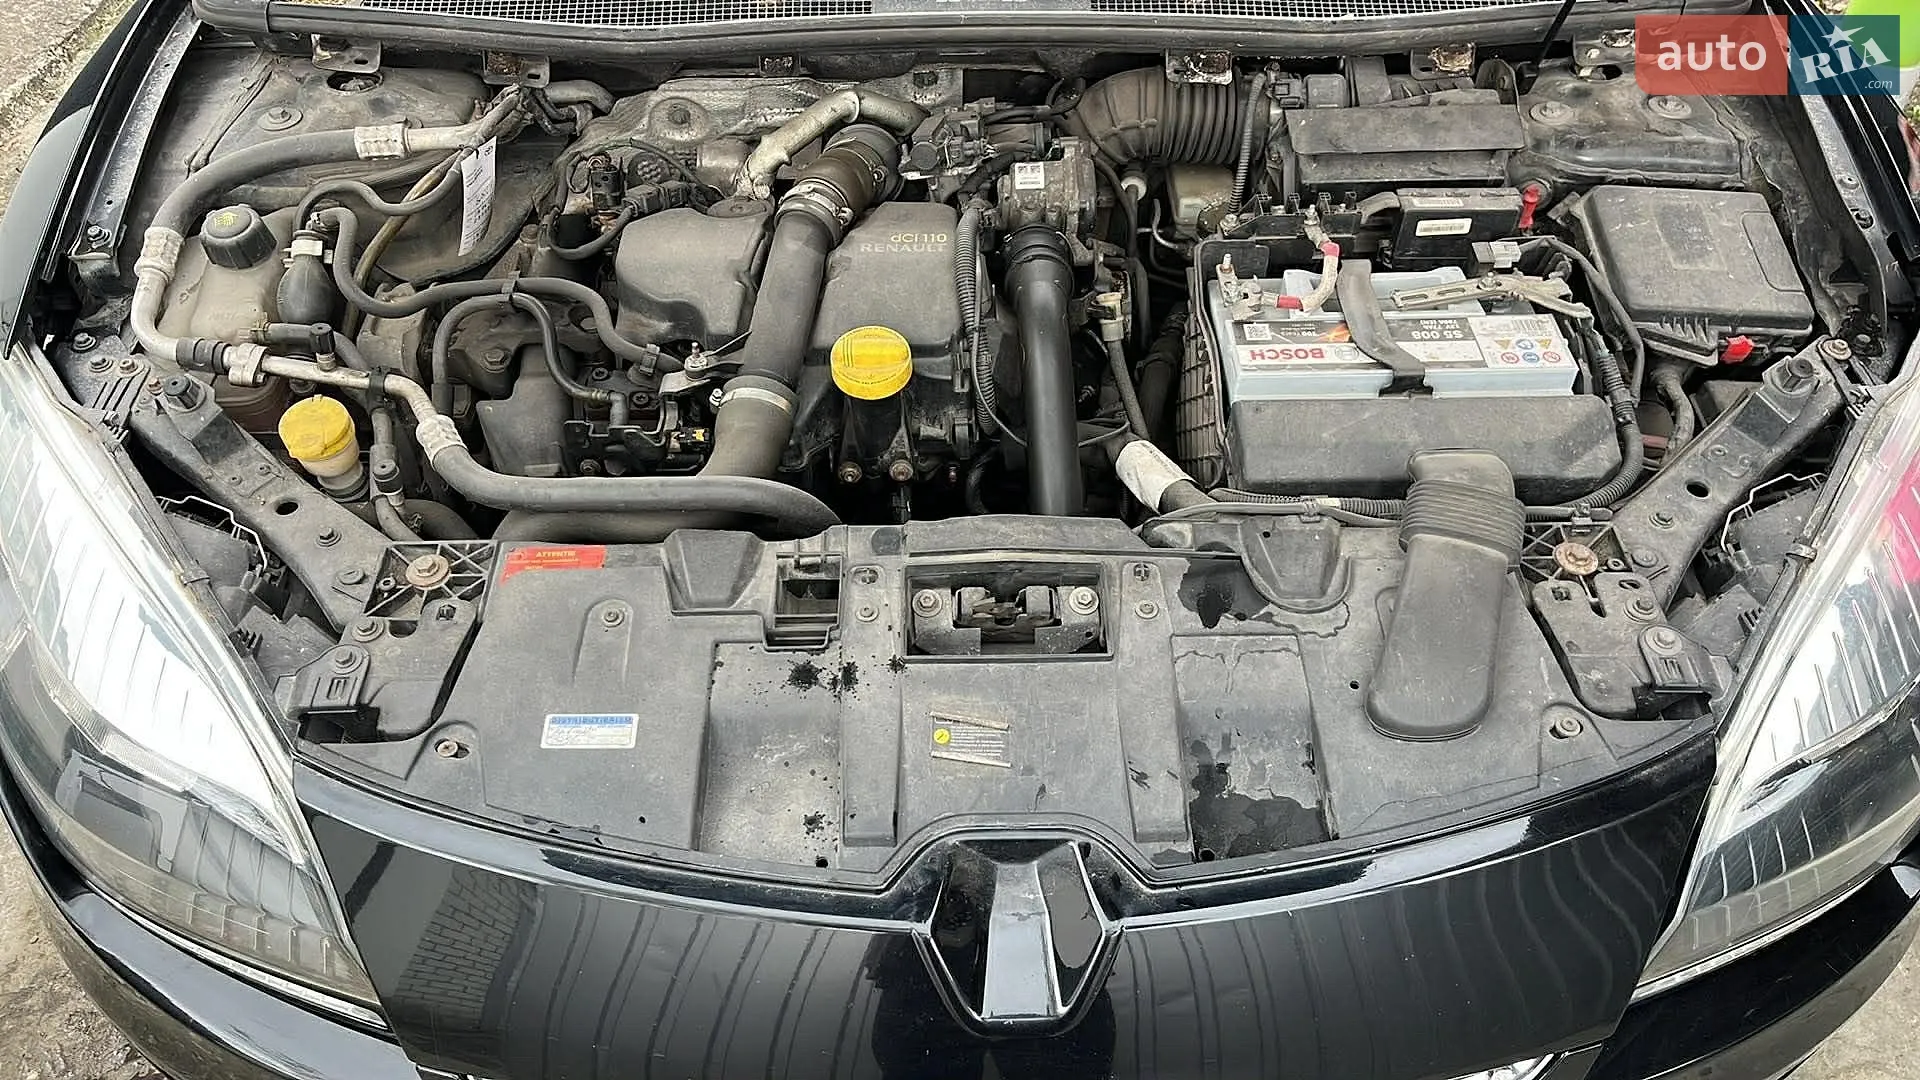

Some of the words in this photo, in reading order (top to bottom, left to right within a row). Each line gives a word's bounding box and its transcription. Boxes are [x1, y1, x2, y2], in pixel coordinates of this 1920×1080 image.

[923, 233, 947, 243] 110
[860, 243, 948, 253] RENAULT
[1411, 330, 1440, 340] 008
[1442, 330, 1464, 339] S5
[1249, 348, 1325, 361] BOSCH
